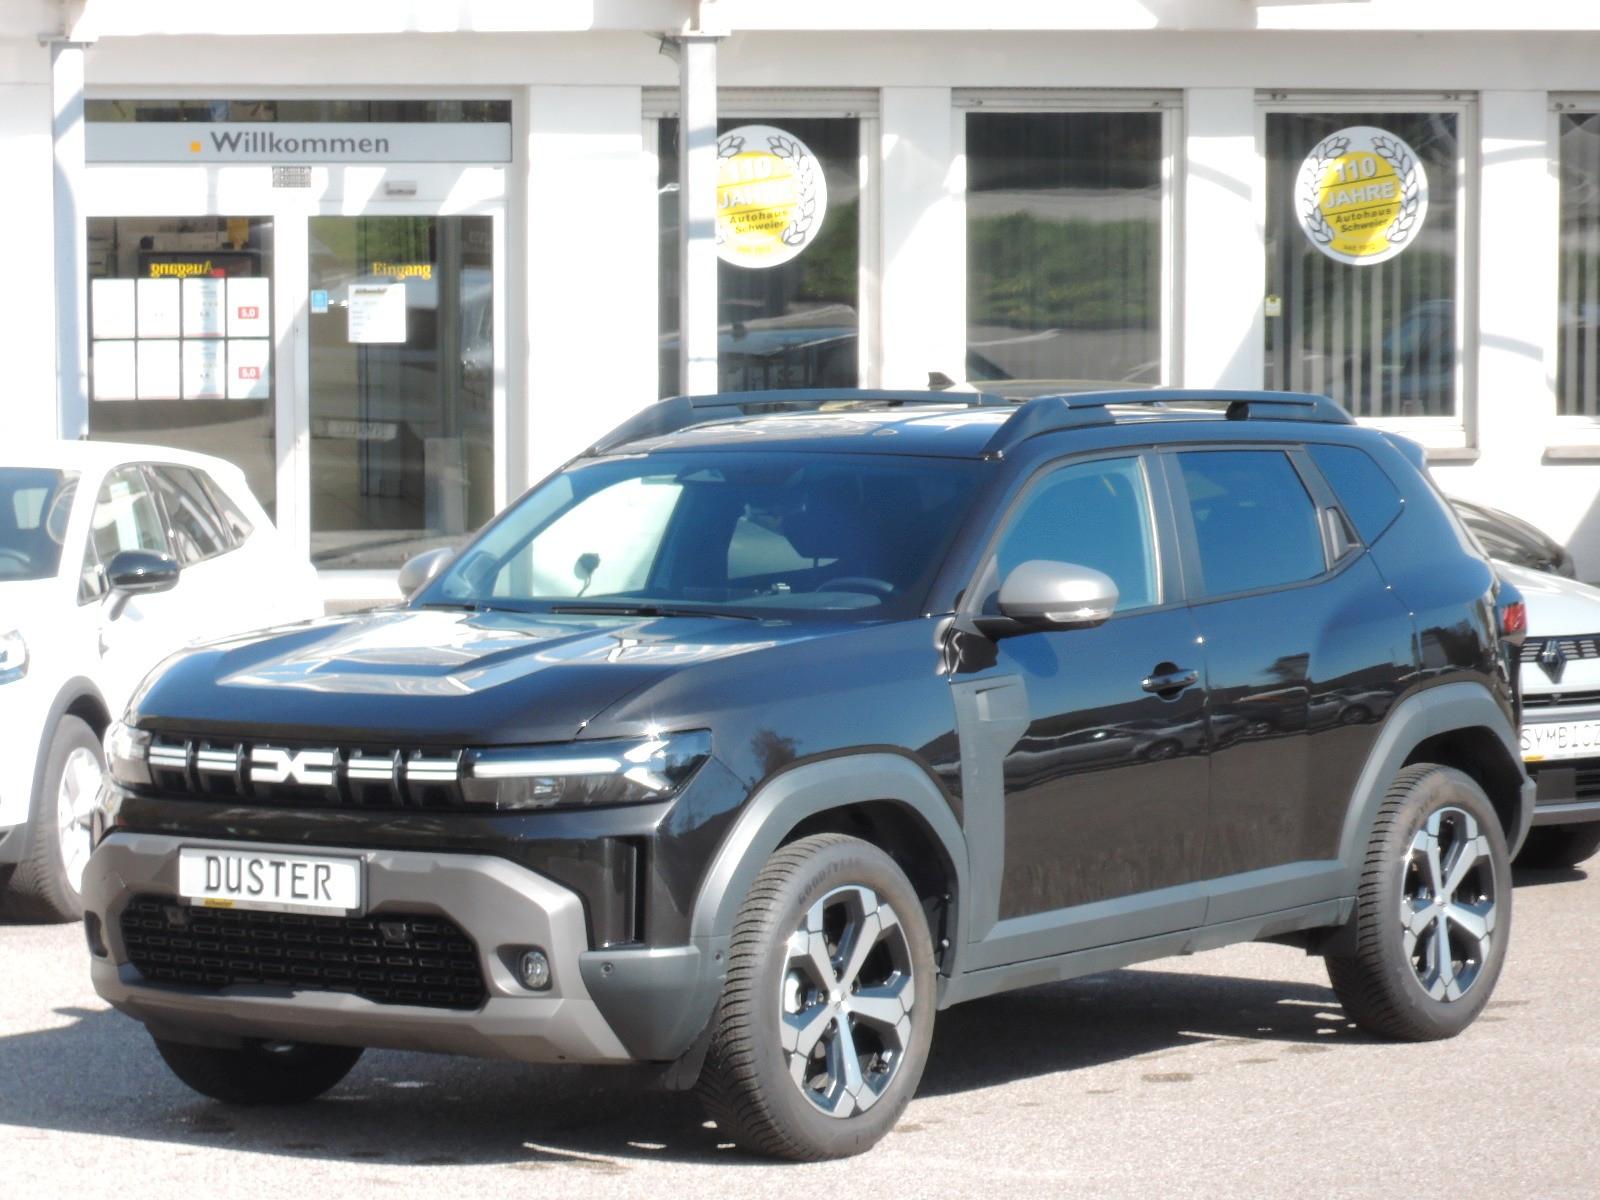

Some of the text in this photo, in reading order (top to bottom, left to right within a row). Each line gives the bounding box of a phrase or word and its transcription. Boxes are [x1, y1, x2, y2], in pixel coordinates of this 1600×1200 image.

[211, 131, 389, 153] Willkommen
[1337, 157, 1376, 181] 110
[1327, 182, 1395, 208] JAHRE
[1336, 208, 1392, 224] Autohaus
[1341, 219, 1388, 233] Schweier
[372, 262, 431, 280] Eingang
[205, 856, 332, 900] DUSTER
